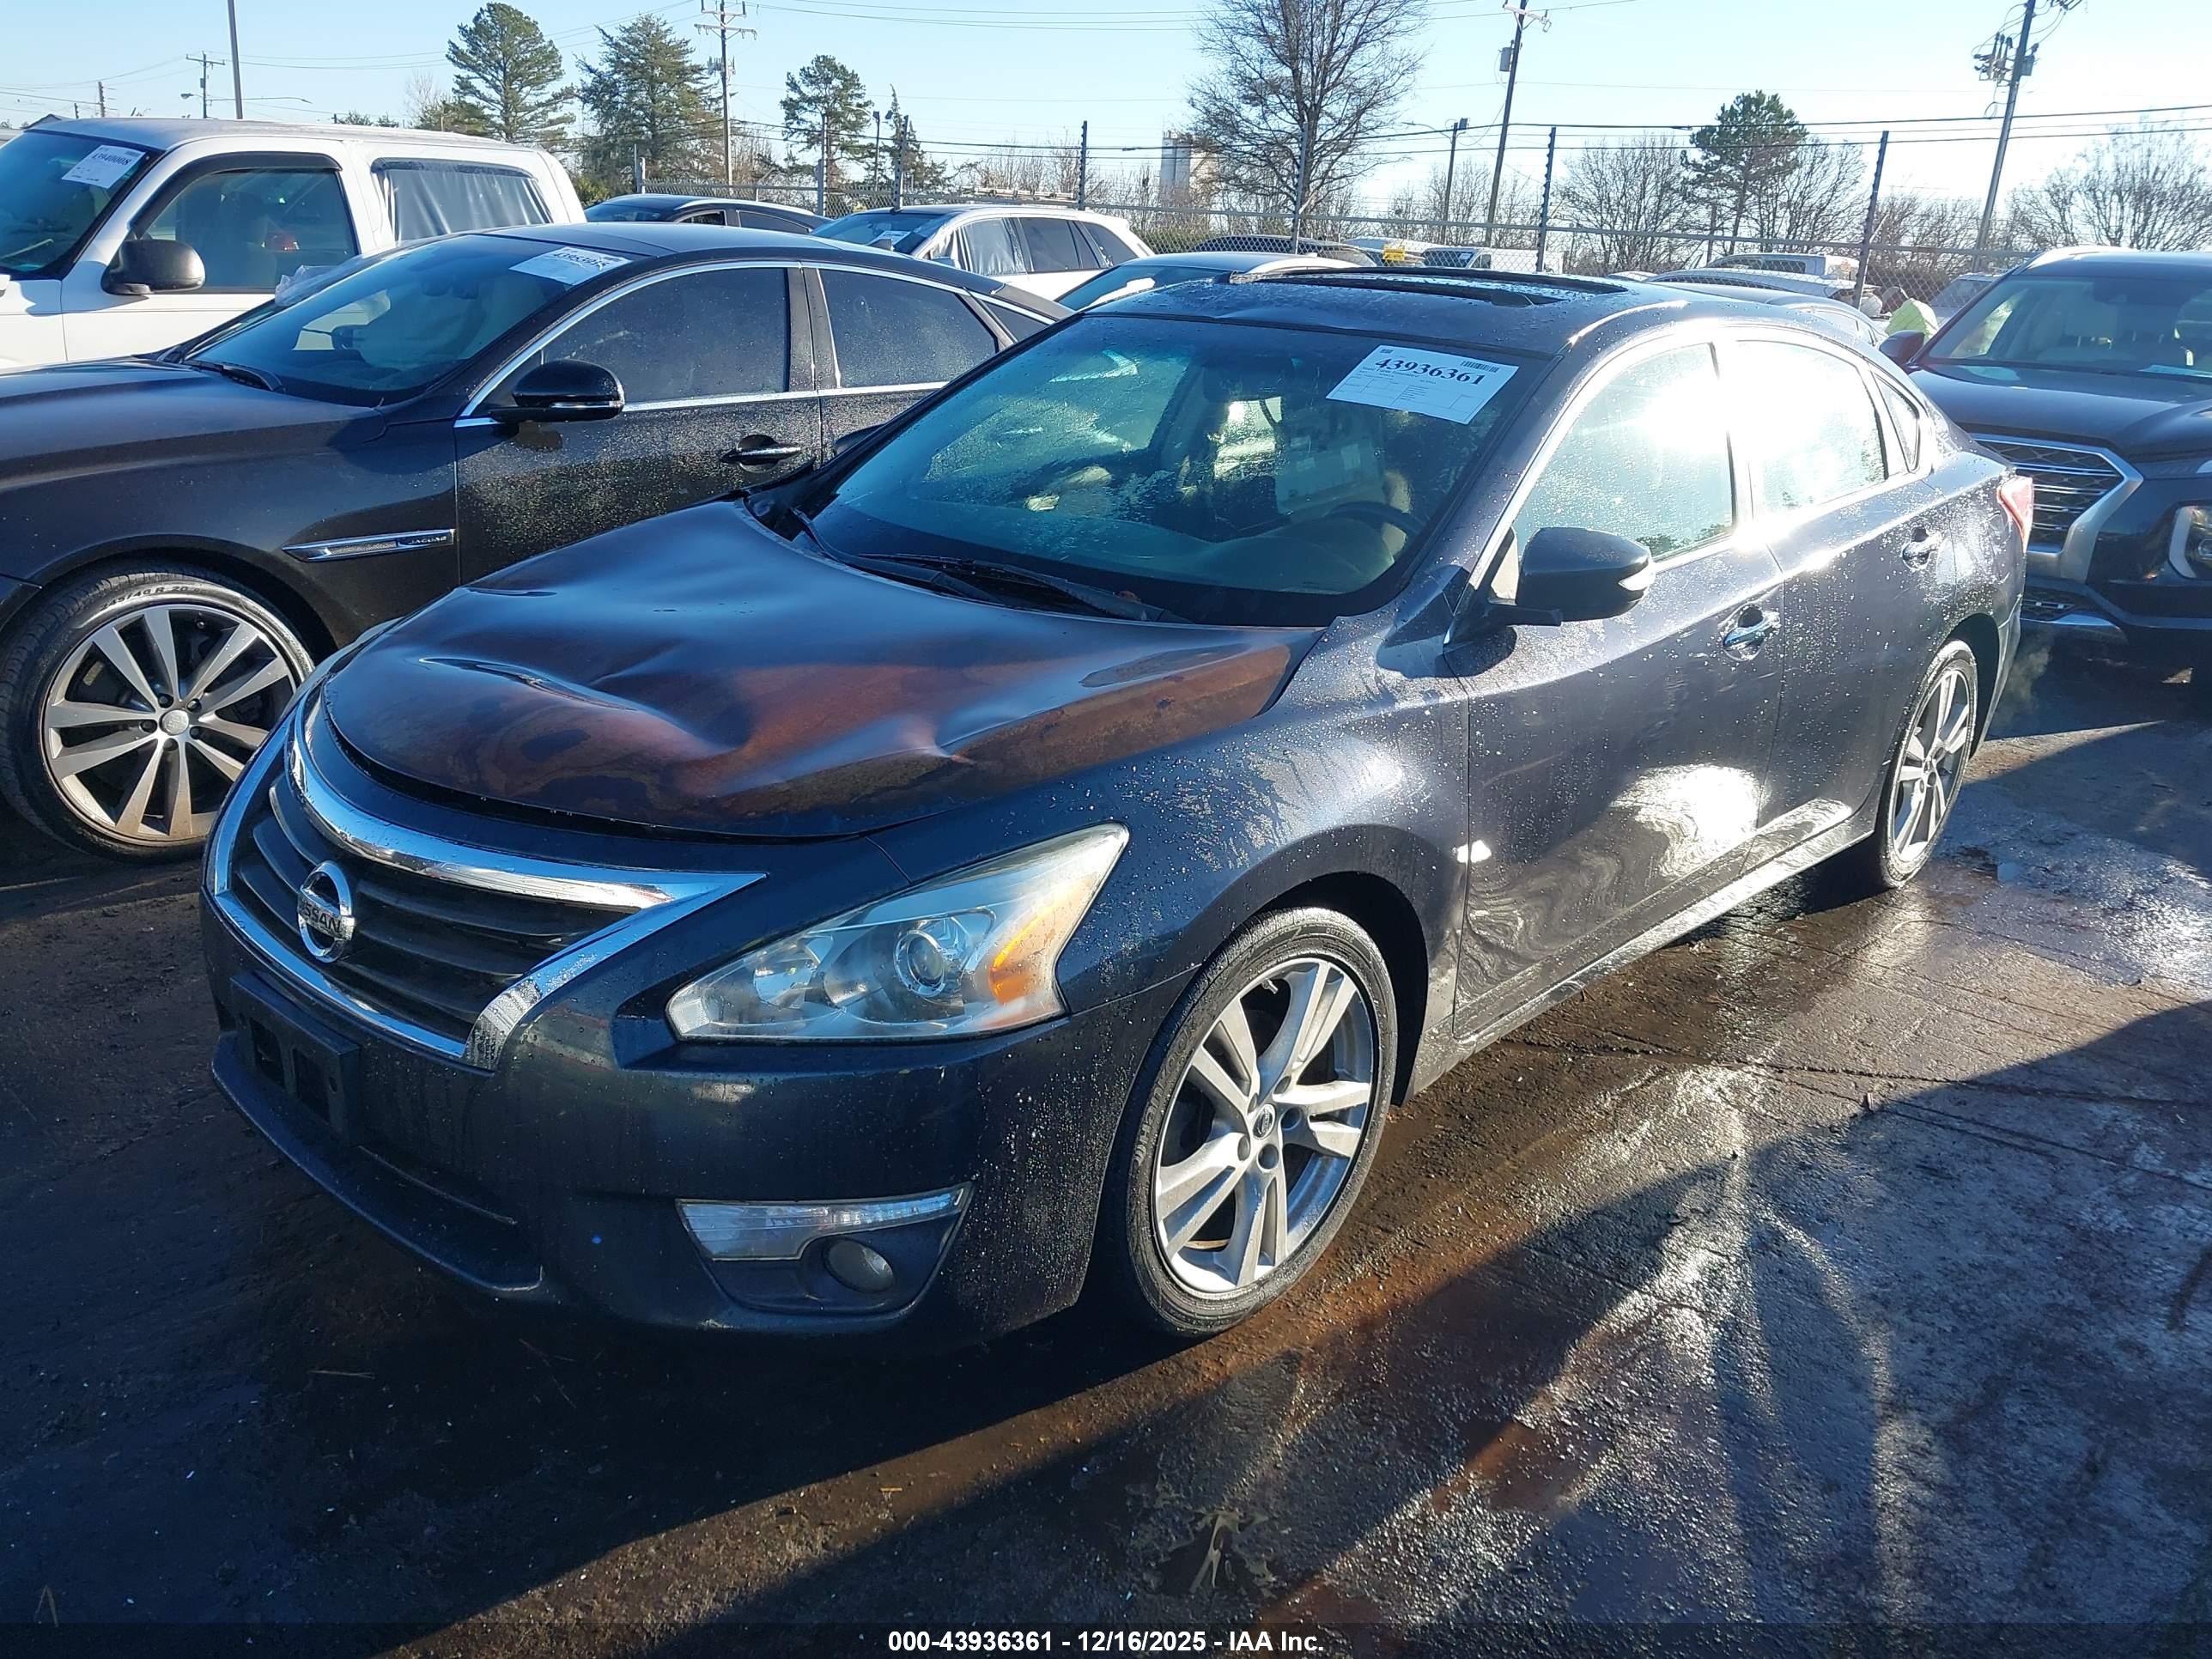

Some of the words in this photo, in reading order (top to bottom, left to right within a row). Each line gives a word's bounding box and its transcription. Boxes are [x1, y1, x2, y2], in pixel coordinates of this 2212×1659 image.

[1376, 357, 1486, 386] 43936361
[408, 536, 447, 544] JAGUAR
[1325, 927, 1355, 944] OUTSIDE
